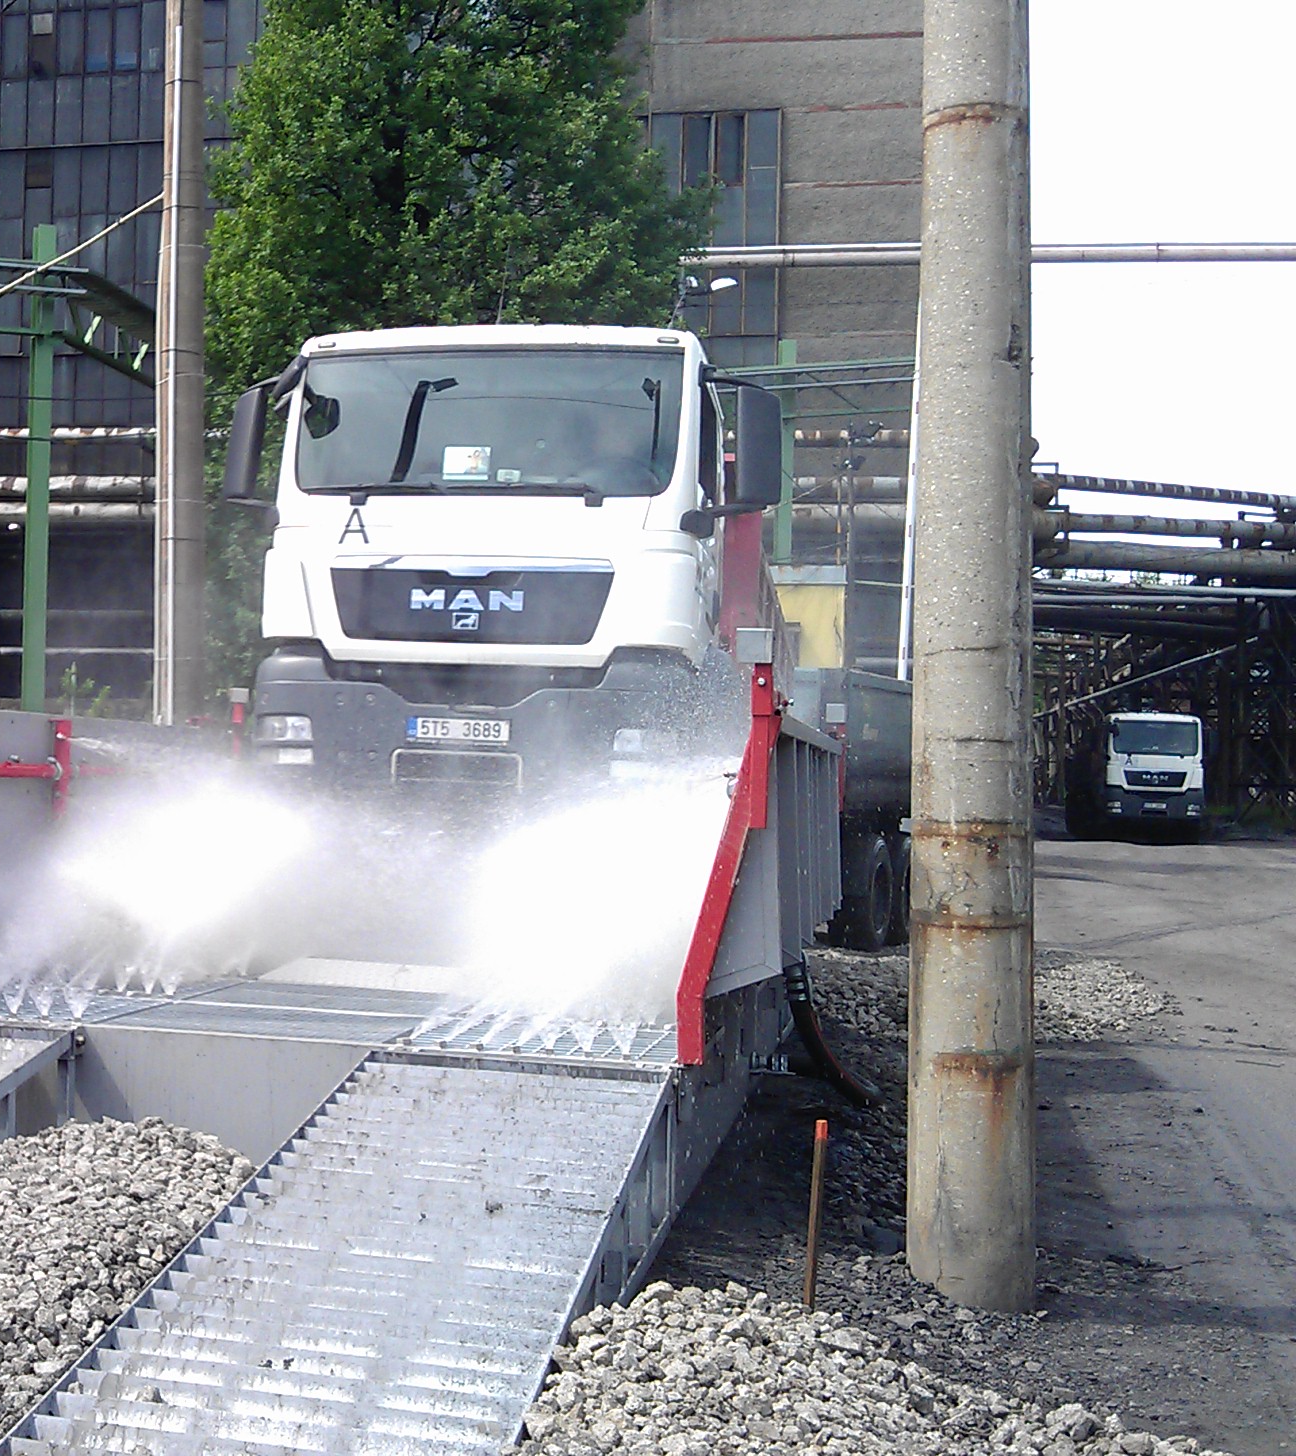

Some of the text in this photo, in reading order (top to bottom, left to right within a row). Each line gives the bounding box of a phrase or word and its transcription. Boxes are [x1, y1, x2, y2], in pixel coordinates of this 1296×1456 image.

[338, 507, 370, 544] A
[410, 588, 524, 612] MAN
[420, 719, 502, 739] 5T5 3689
